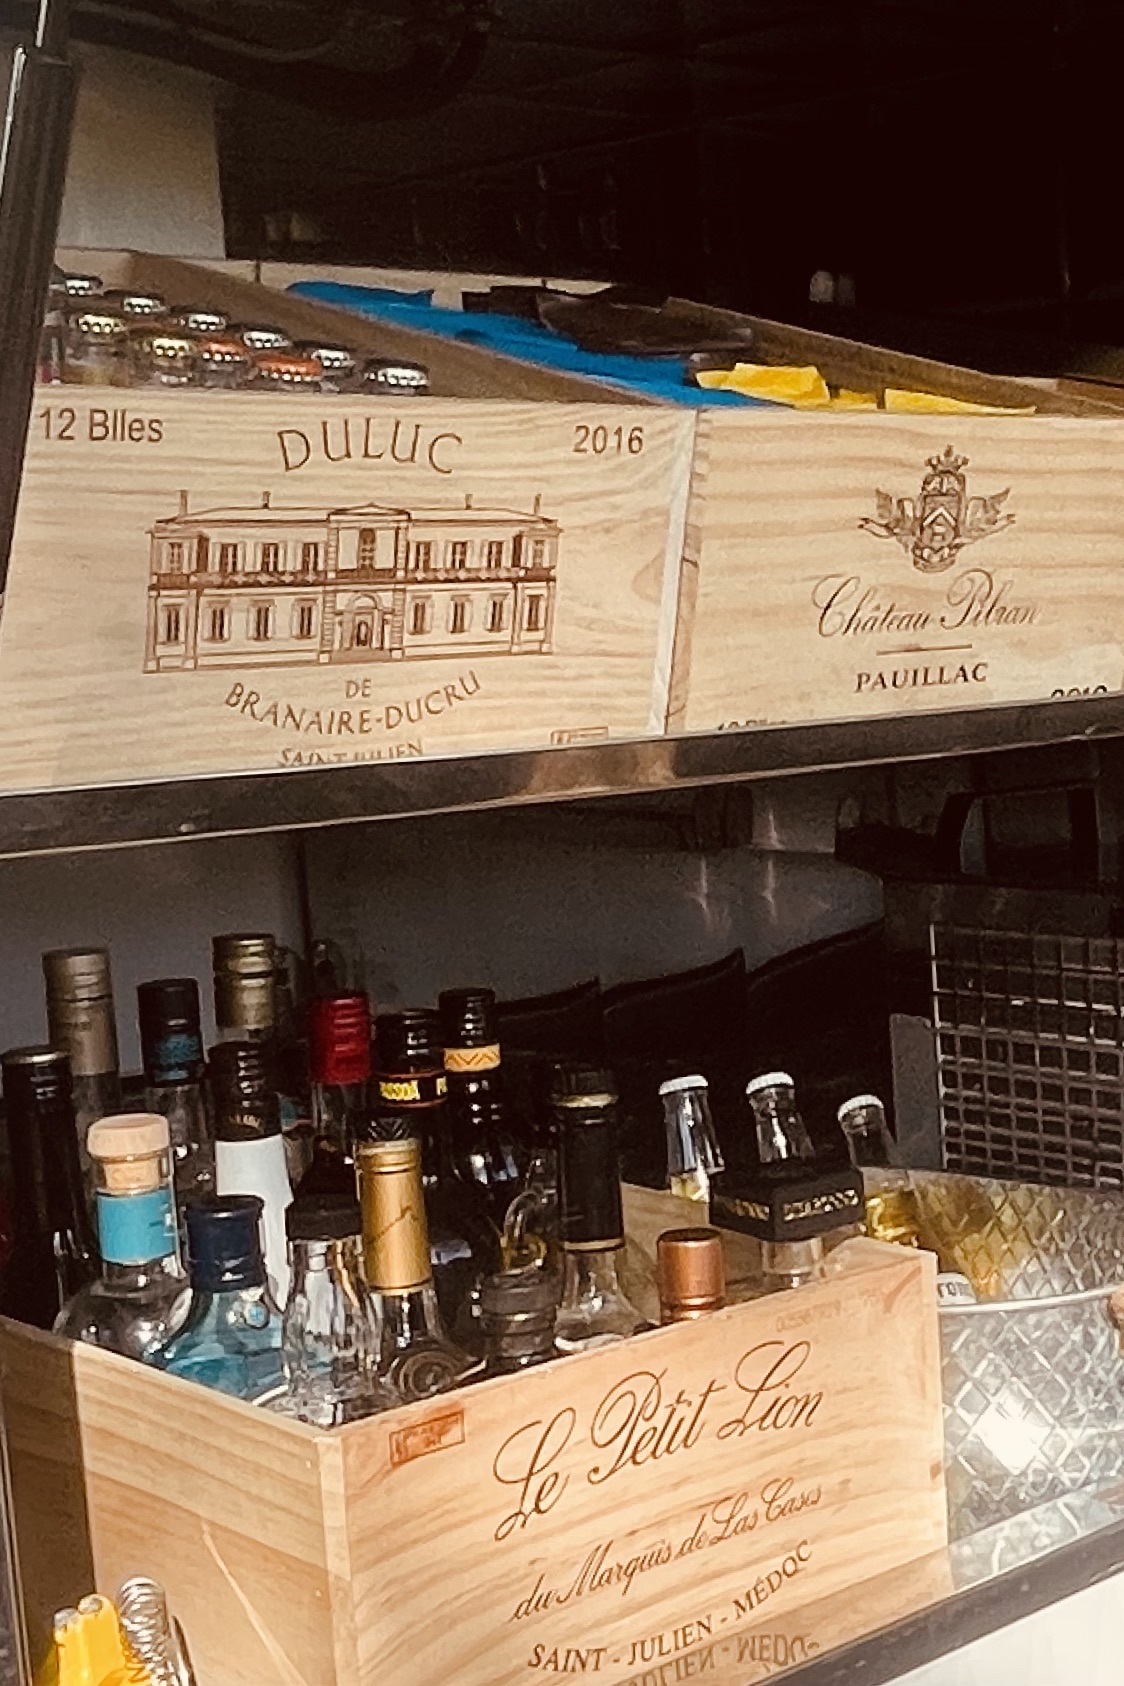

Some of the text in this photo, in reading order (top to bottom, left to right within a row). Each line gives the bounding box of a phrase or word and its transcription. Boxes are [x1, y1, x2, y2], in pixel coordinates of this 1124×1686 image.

[39, 407, 163, 442] 12 Blles
[277, 416, 463, 474] DULUC
[573, 425, 643, 454] 2016
[811, 572, 931, 638] Château
[224, 669, 481, 735] BRANAIRE-DUCRU
[345, 678, 372, 699] DE
[854, 662, 989, 693] PAUILLAC
[493, 1340, 824, 1541] Le Petit Lion
[507, 1573, 556, 1623] du
[556, 1539, 674, 1596] Marquis
[675, 1513, 708, 1559] de
[709, 1491, 759, 1545] Las
[528, 1643, 608, 1673] SAINT
[627, 1614, 714, 1666] JULIEN
[732, 1539, 813, 1622] MÉDOC
